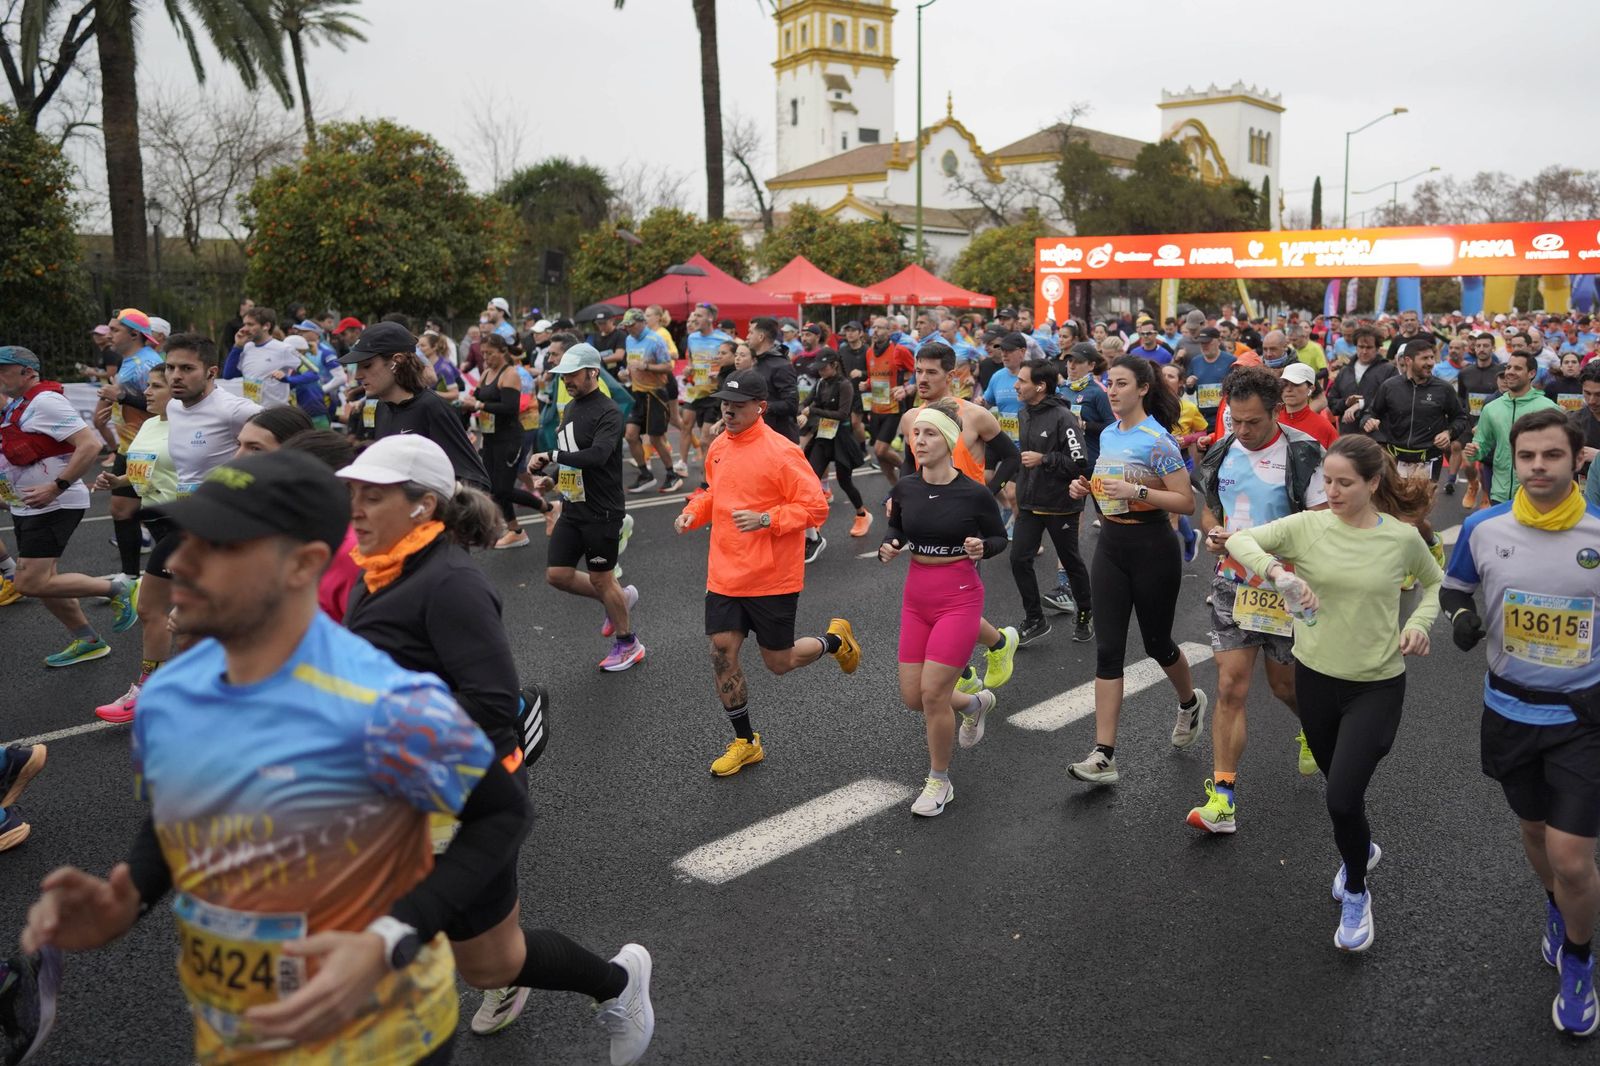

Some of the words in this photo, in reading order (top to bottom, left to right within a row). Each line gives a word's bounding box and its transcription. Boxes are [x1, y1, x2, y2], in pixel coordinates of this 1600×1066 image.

[1066, 427, 1084, 462] adid
[918, 545, 950, 555] NIKE
[950, 546, 967, 555] PR
[1241, 589, 1286, 611] 13624
[1510, 607, 1578, 637] 13615
[191, 937, 275, 992] 5424
